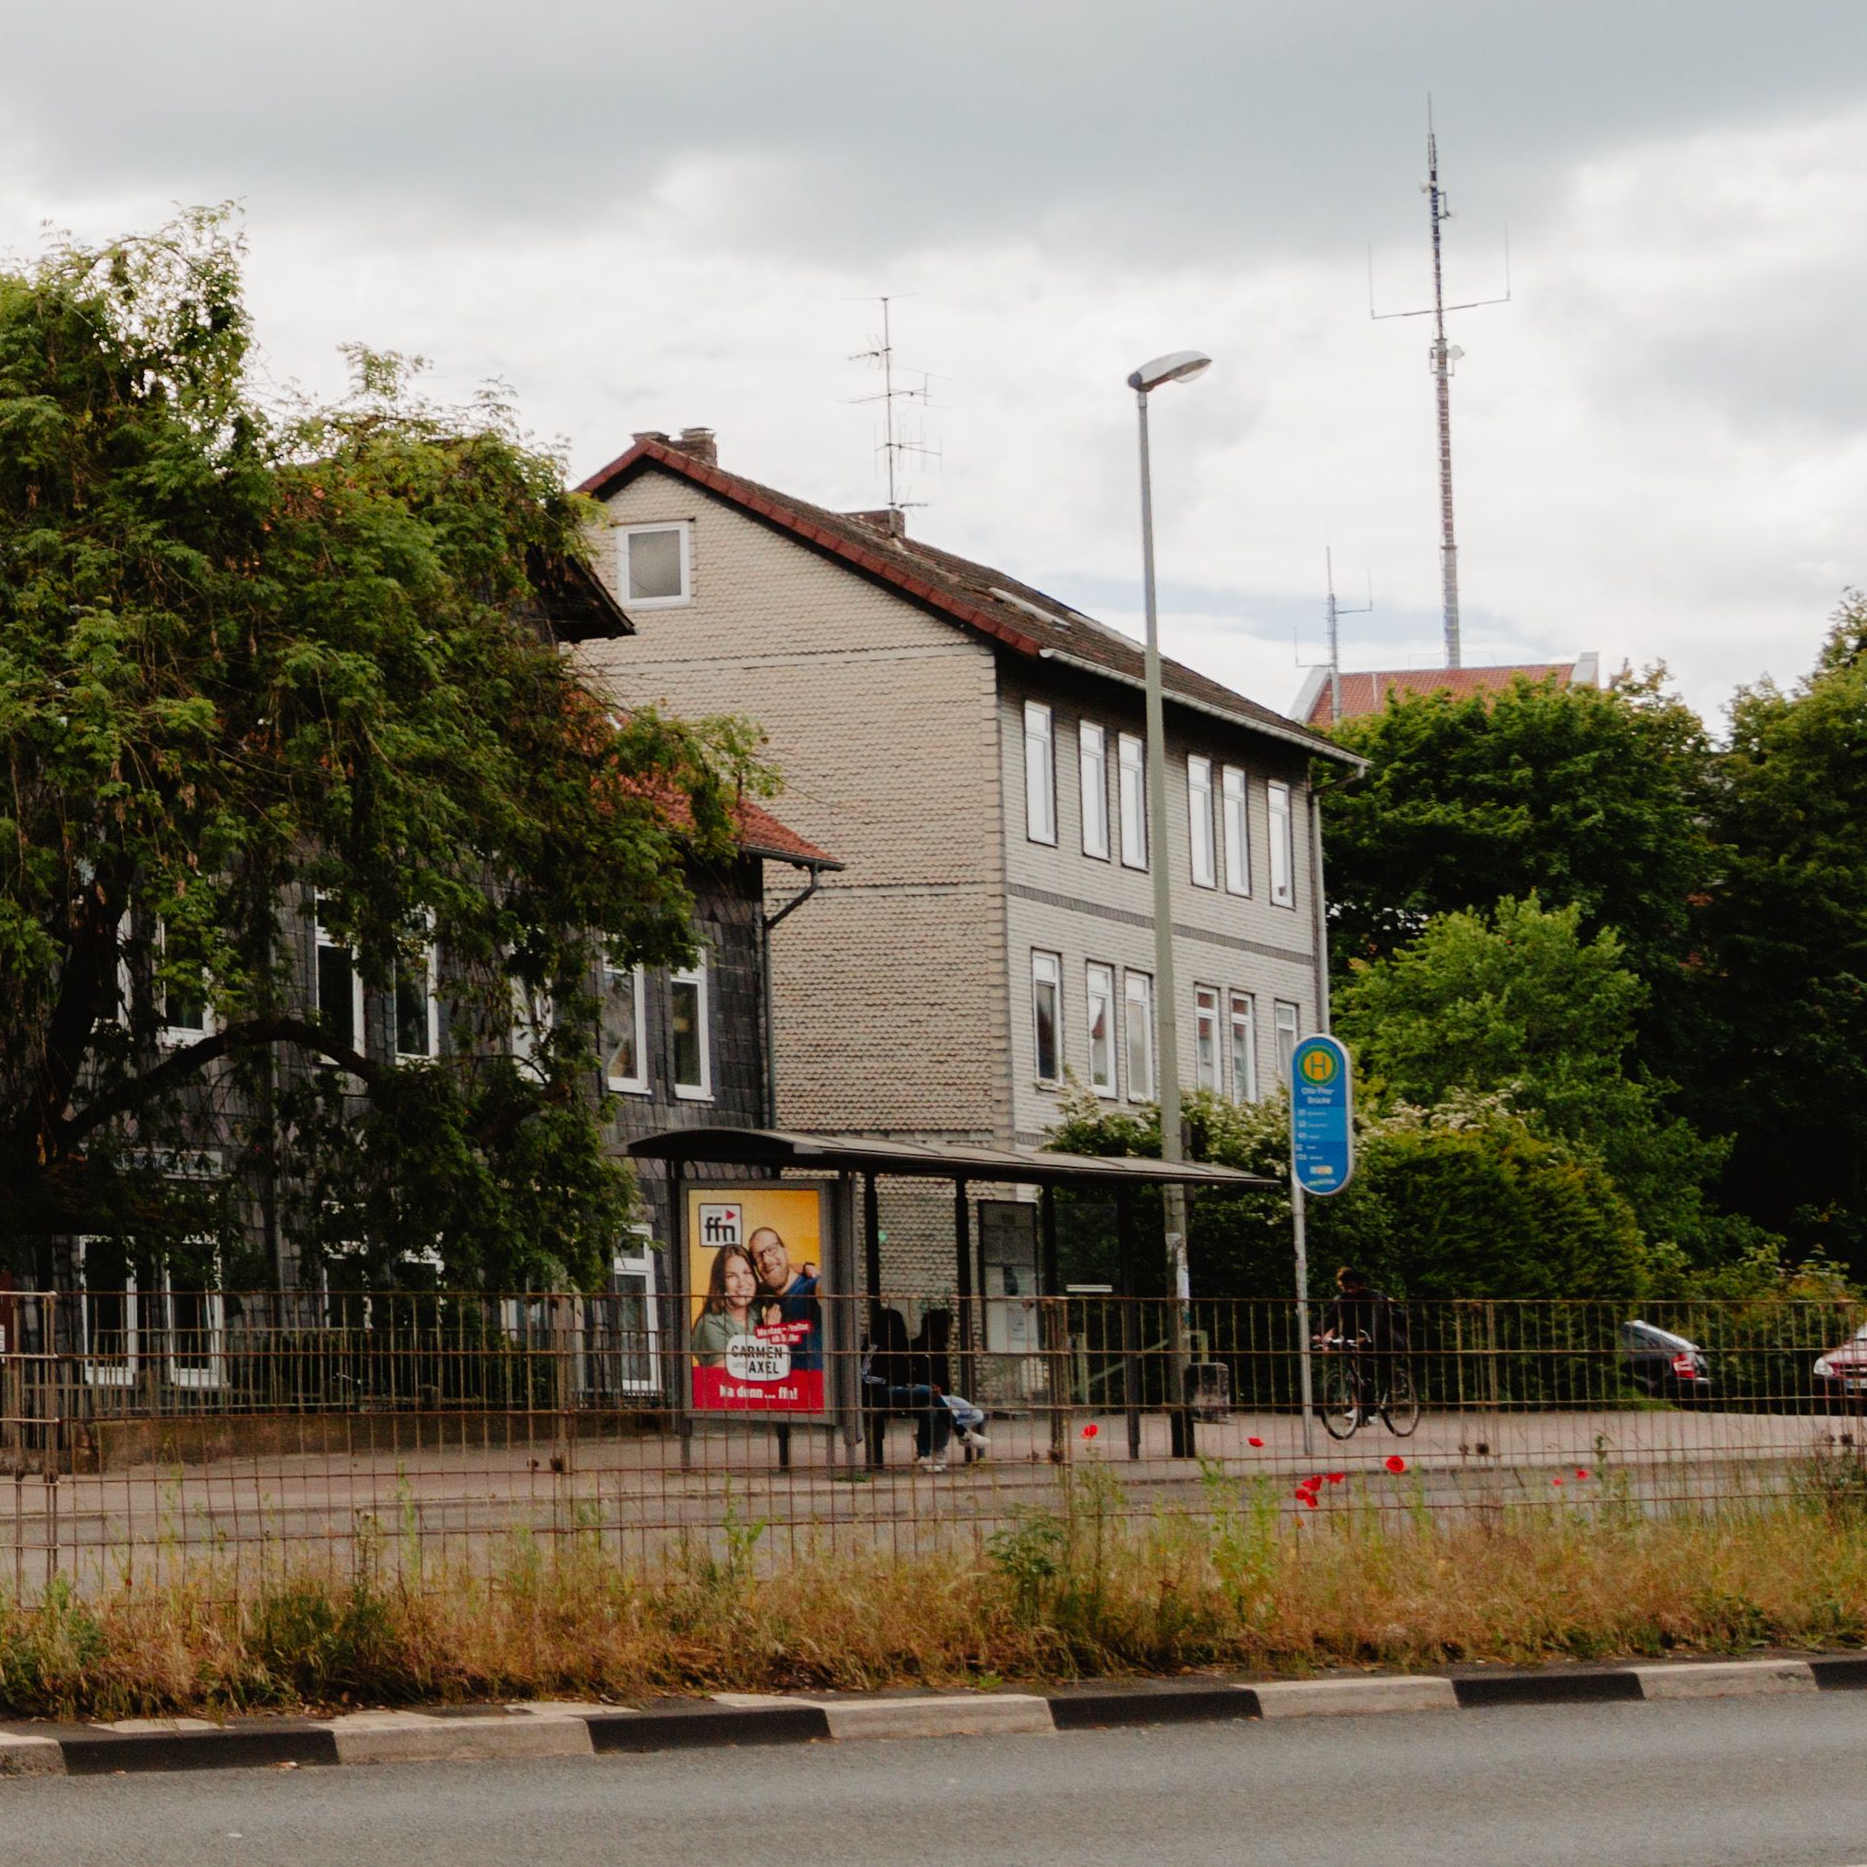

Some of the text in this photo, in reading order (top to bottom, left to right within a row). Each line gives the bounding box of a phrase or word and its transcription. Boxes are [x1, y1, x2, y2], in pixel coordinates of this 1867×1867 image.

[704, 1216, 735, 1242] ffn
[731, 1345, 783, 1359] CARMEN
[748, 1361, 780, 1374] AXEL
